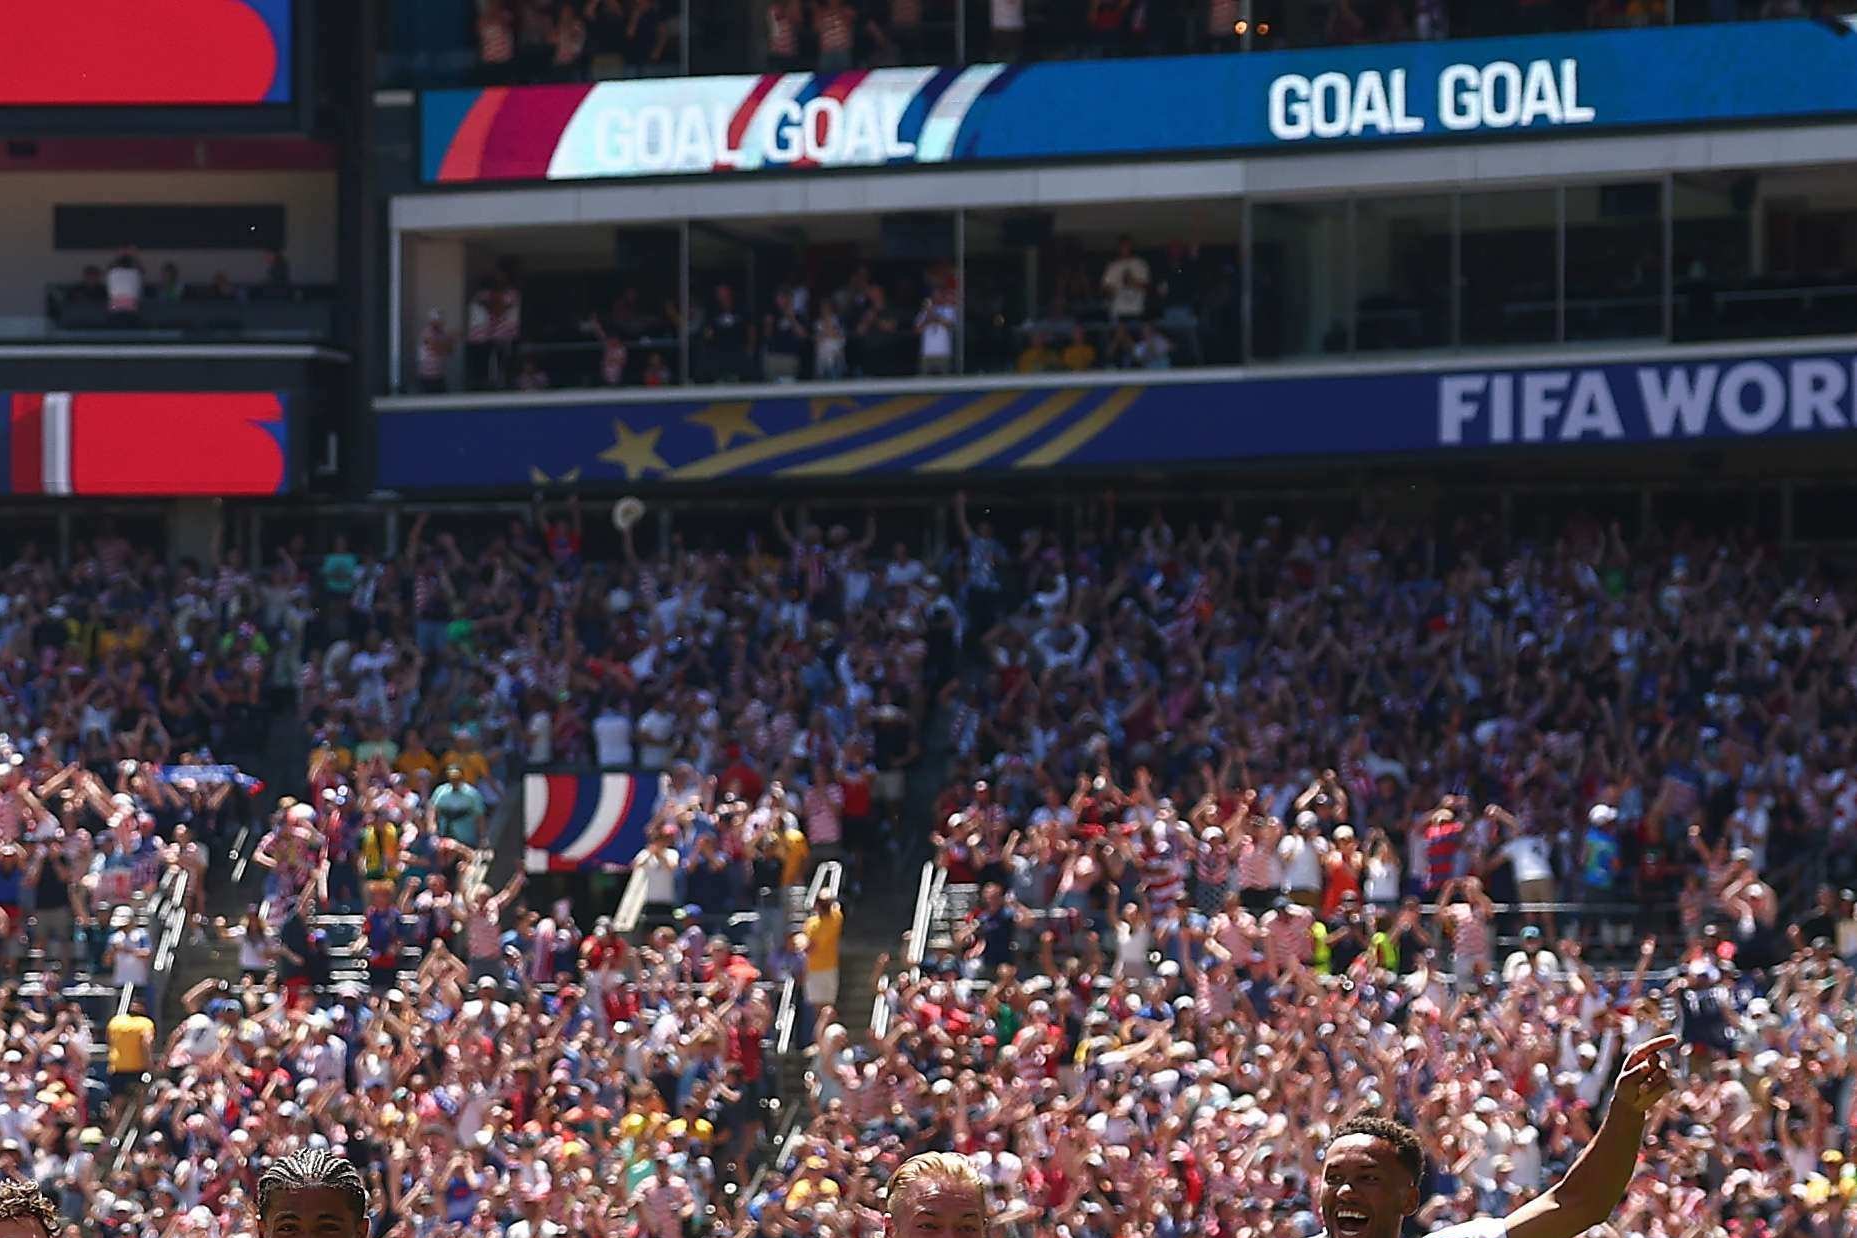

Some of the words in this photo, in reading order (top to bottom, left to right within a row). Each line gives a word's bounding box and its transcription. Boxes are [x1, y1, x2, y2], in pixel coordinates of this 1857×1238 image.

[595, 103, 740, 170] GOAL
[763, 92, 916, 162] GOAL
[1268, 68, 1424, 140] GOAL
[1437, 58, 1596, 130] GOAL
[1438, 369, 1625, 443] FIFA
[1637, 357, 1857, 437] WOR
